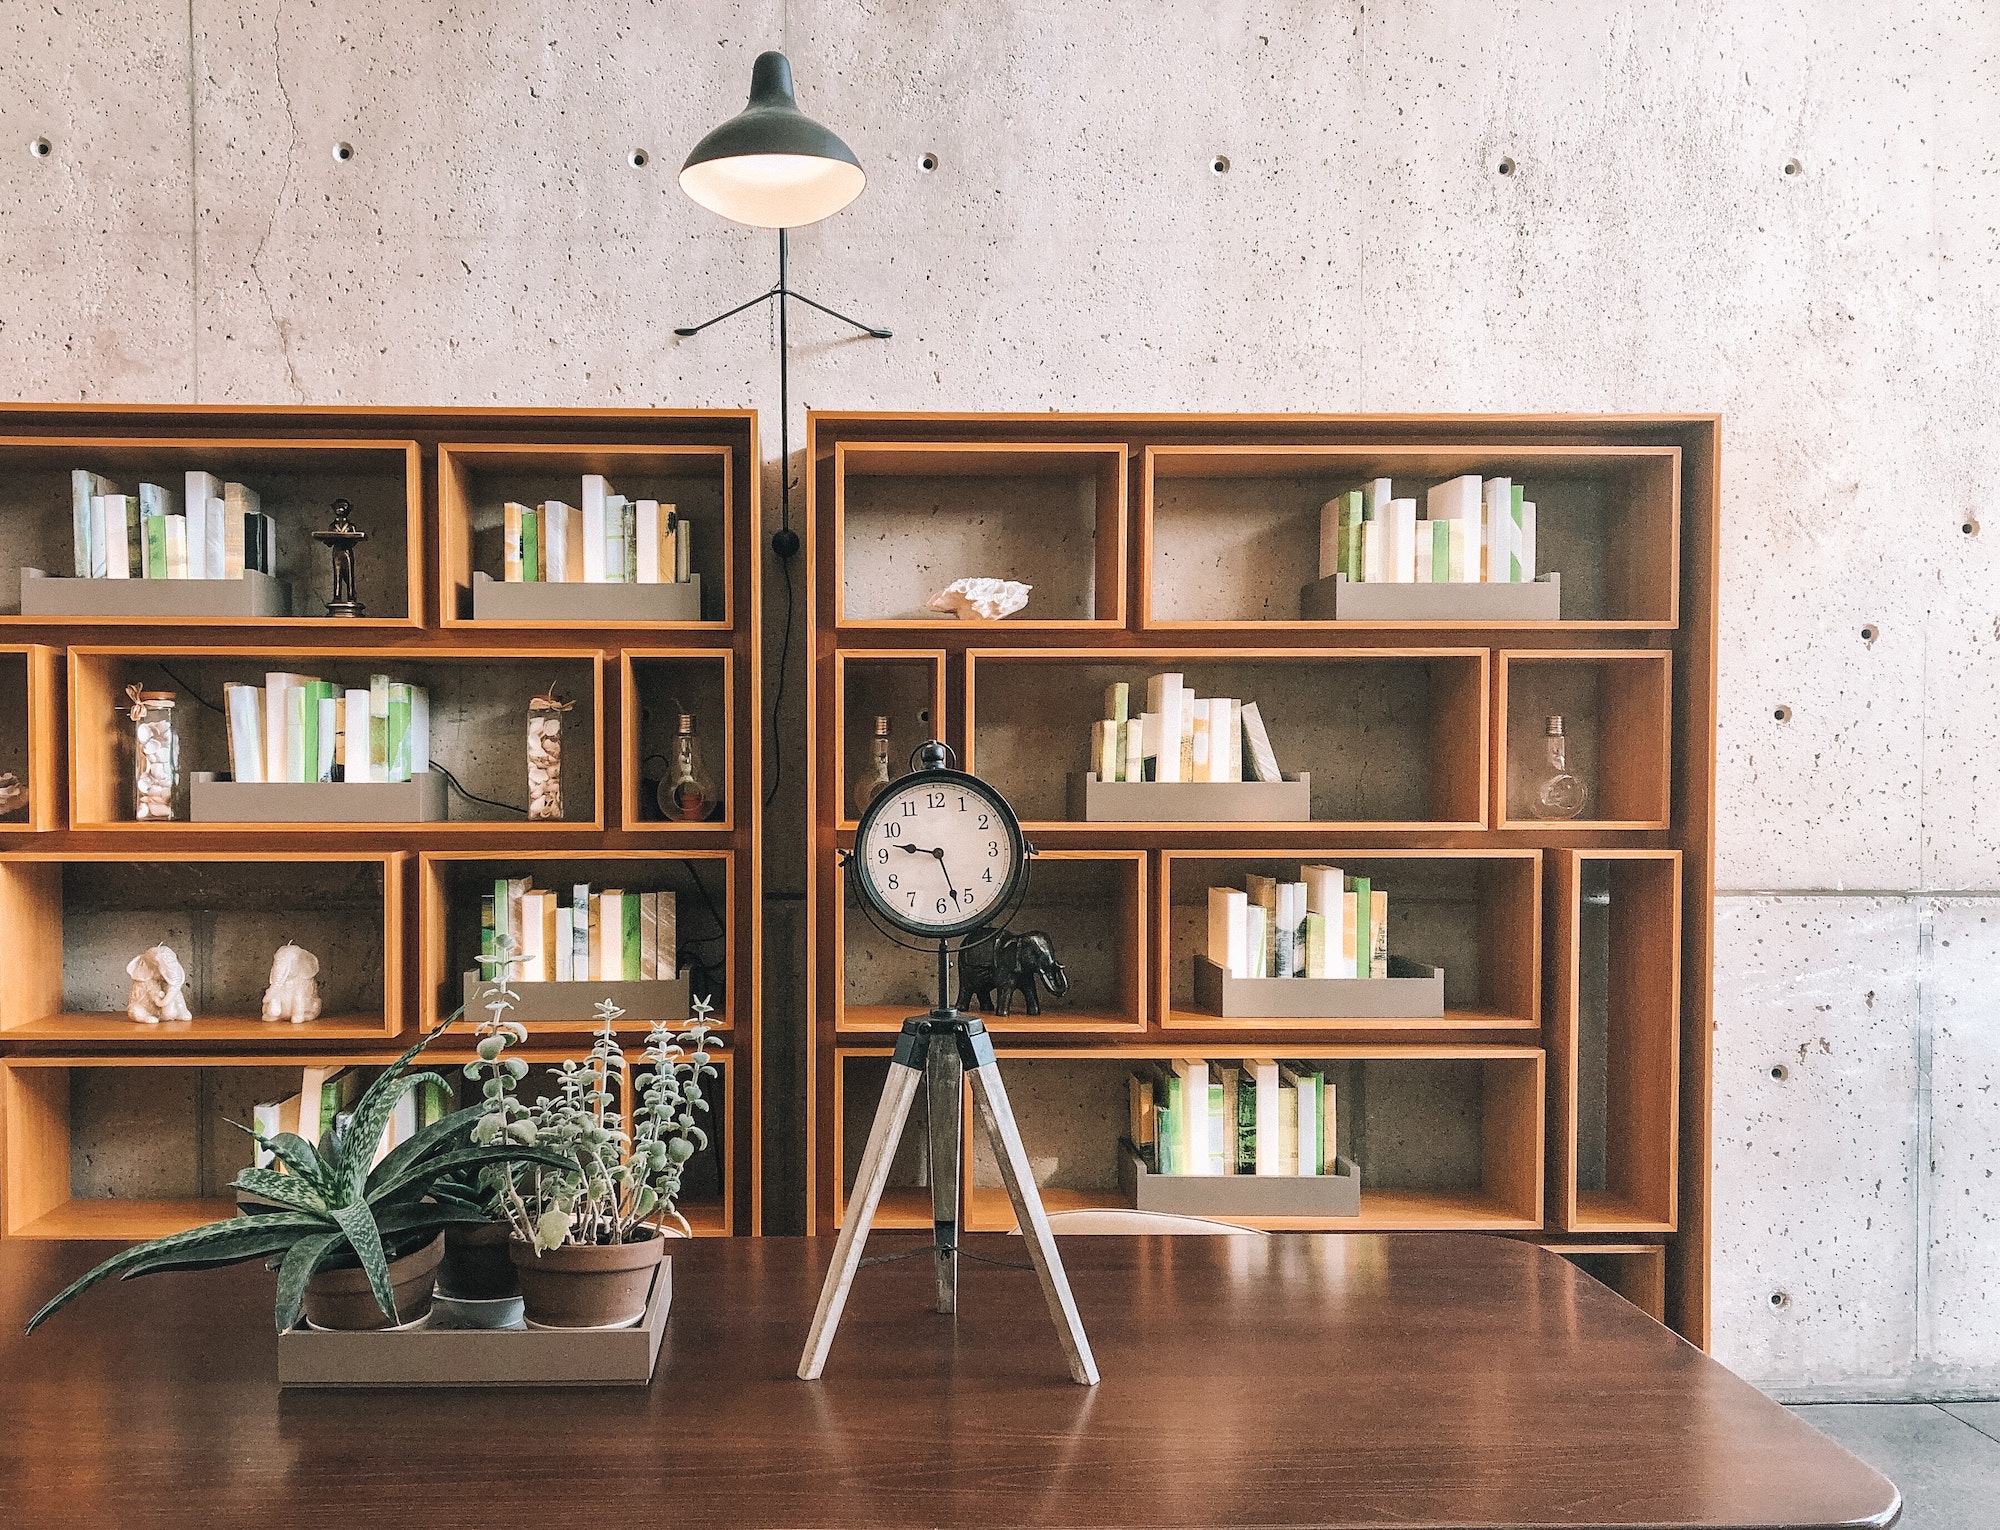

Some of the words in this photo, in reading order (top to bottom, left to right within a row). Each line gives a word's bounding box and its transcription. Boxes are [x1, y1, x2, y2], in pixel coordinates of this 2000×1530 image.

[927, 793, 945, 808] 12
[958, 797, 967, 812] 1
[901, 801, 917, 817] 11
[884, 822, 900, 838] 10
[978, 815, 988, 830] 2
[879, 849, 888, 864] 9
[989, 841, 998, 857] 3
[889, 874, 898, 889] 8
[982, 867, 992, 882] 4
[907, 892, 915, 907] 7
[964, 888, 974, 903] 5
[936, 898, 946, 914] 6
